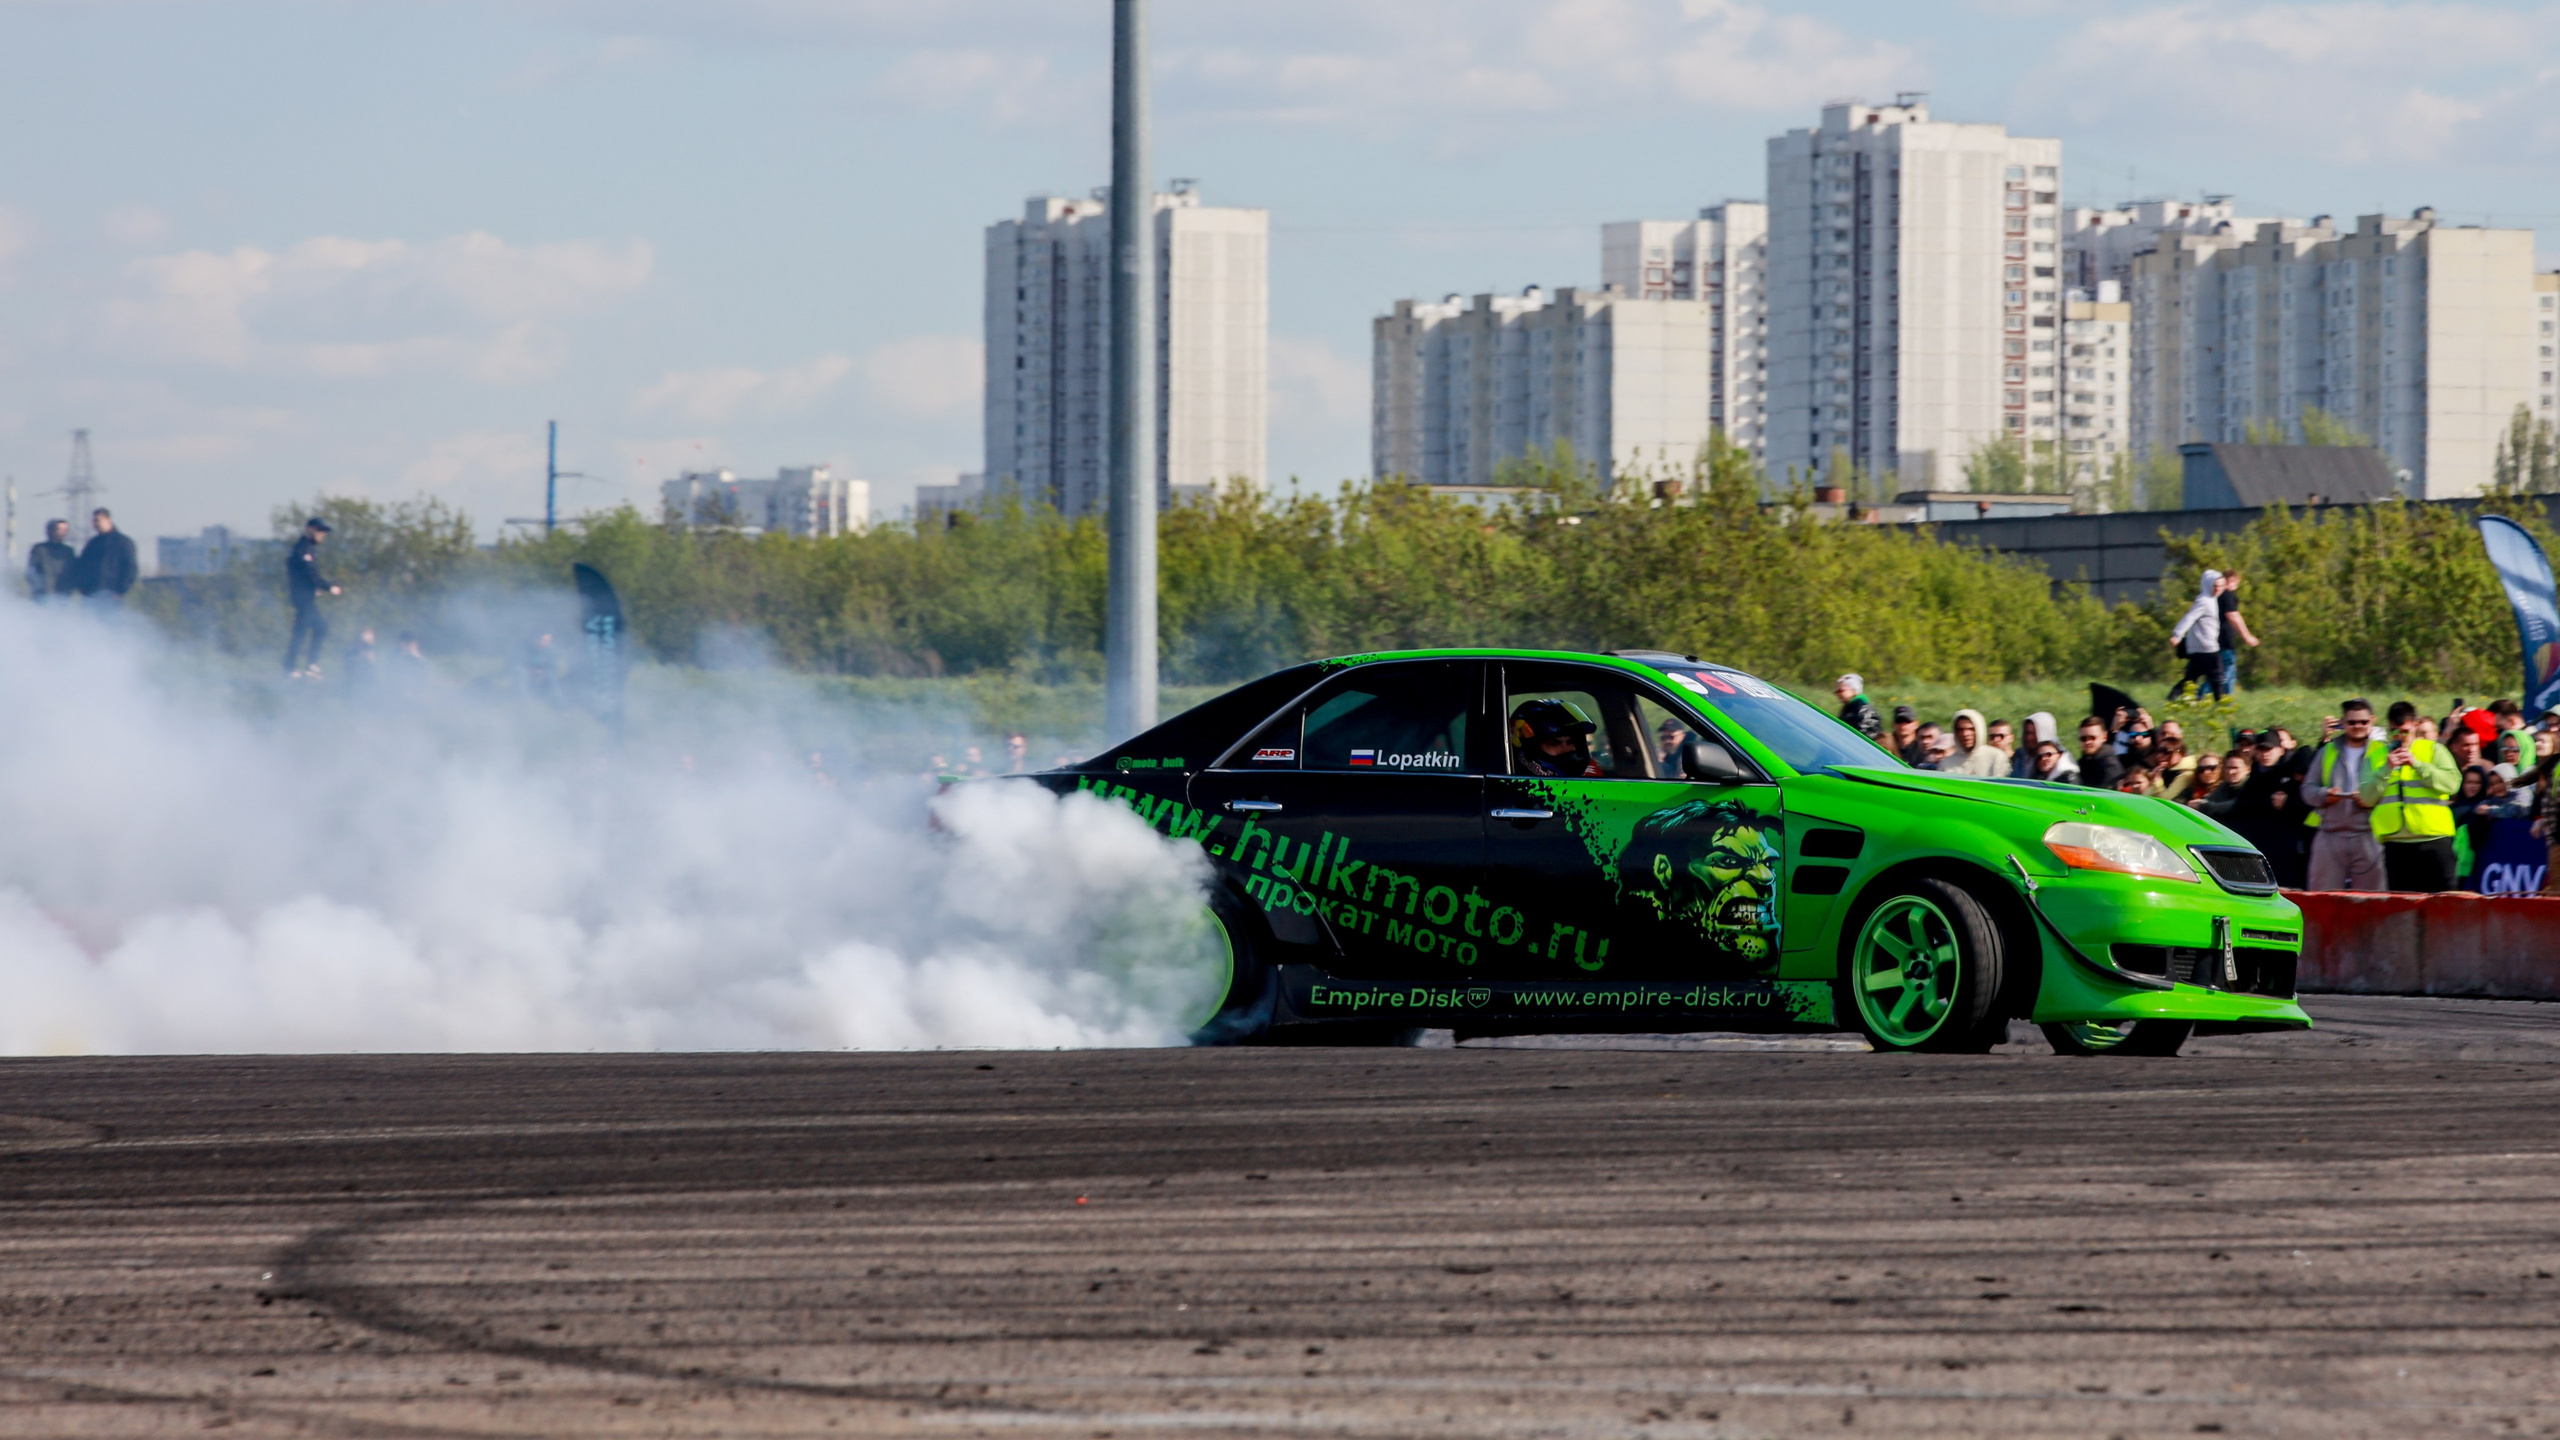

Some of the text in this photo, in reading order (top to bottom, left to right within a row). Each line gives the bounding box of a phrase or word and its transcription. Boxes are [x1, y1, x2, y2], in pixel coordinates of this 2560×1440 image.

[1376, 749, 1460, 770] Lopatkin
[1245, 874, 1379, 936] прокат
[1310, 985, 1405, 1010] Empire
[1410, 988, 1464, 1007] Disk
[1513, 986, 1772, 1011] www.empire-disk.ru
